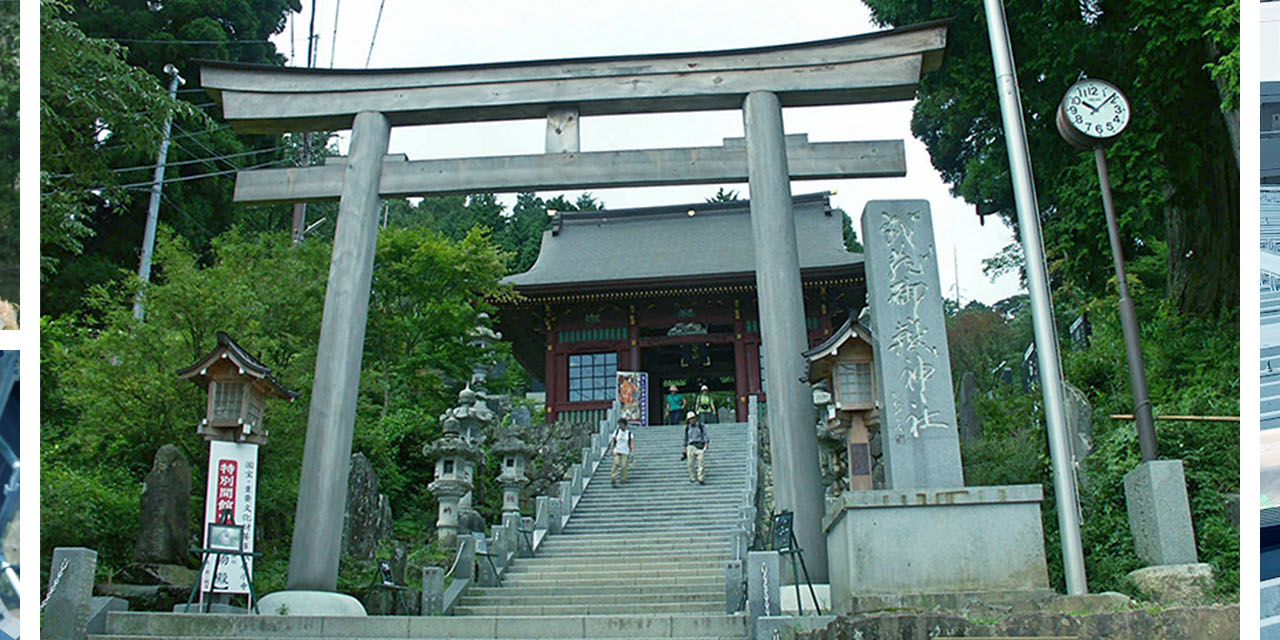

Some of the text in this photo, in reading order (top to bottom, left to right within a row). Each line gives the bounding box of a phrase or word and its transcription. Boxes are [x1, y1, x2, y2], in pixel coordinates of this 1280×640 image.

[1078, 88, 1087, 97] 11
[1088, 87, 1099, 96] 12
[1069, 106, 1078, 115] 9
[1114, 105, 1122, 114] 3
[1075, 115, 1083, 124] 8
[1112, 115, 1120, 123] 4
[1085, 122, 1092, 131] 7
[1095, 124, 1103, 134] 6
[1106, 122, 1114, 131] 5
